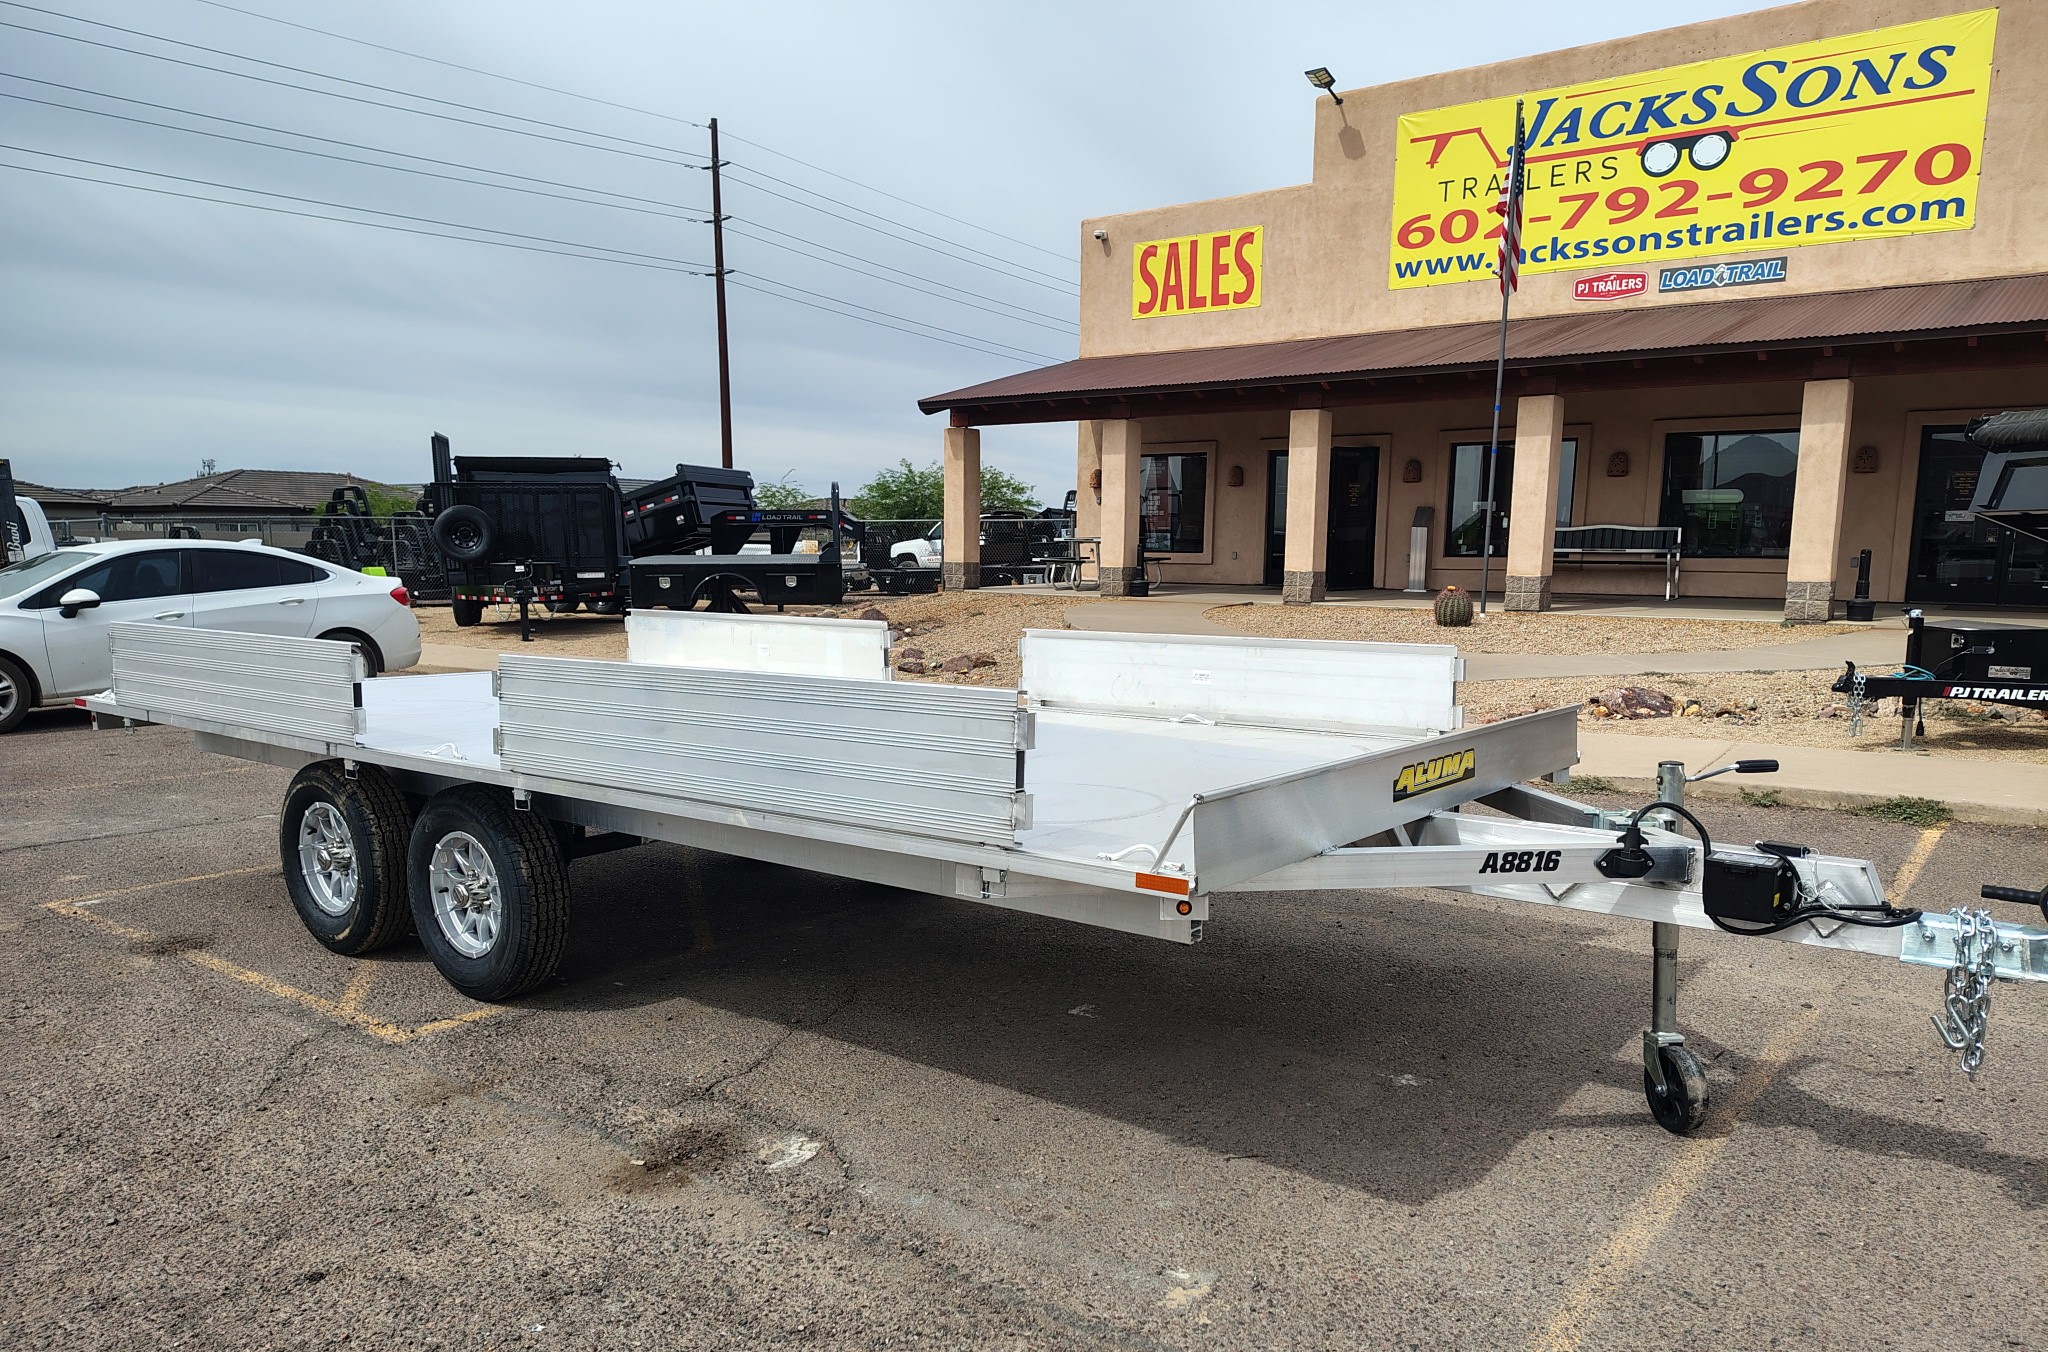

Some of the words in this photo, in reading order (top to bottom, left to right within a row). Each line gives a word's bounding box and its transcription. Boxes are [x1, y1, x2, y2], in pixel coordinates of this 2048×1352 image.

[1438, 156, 1618, 202] TRALERS
[1395, 197, 1965, 278] www.ckssonstrailers.com
[1138, 232, 1255, 314] SALES
[1577, 283, 1589, 294] PJ
[1592, 278, 1643, 293] TRAILERS
[1660, 266, 1715, 290] LOAD
[1726, 261, 1785, 283] TRAIL
[1949, 686, 1971, 698] PJ
[1395, 749, 1475, 792] ALUMA
[1479, 850, 1562, 874] A8816
